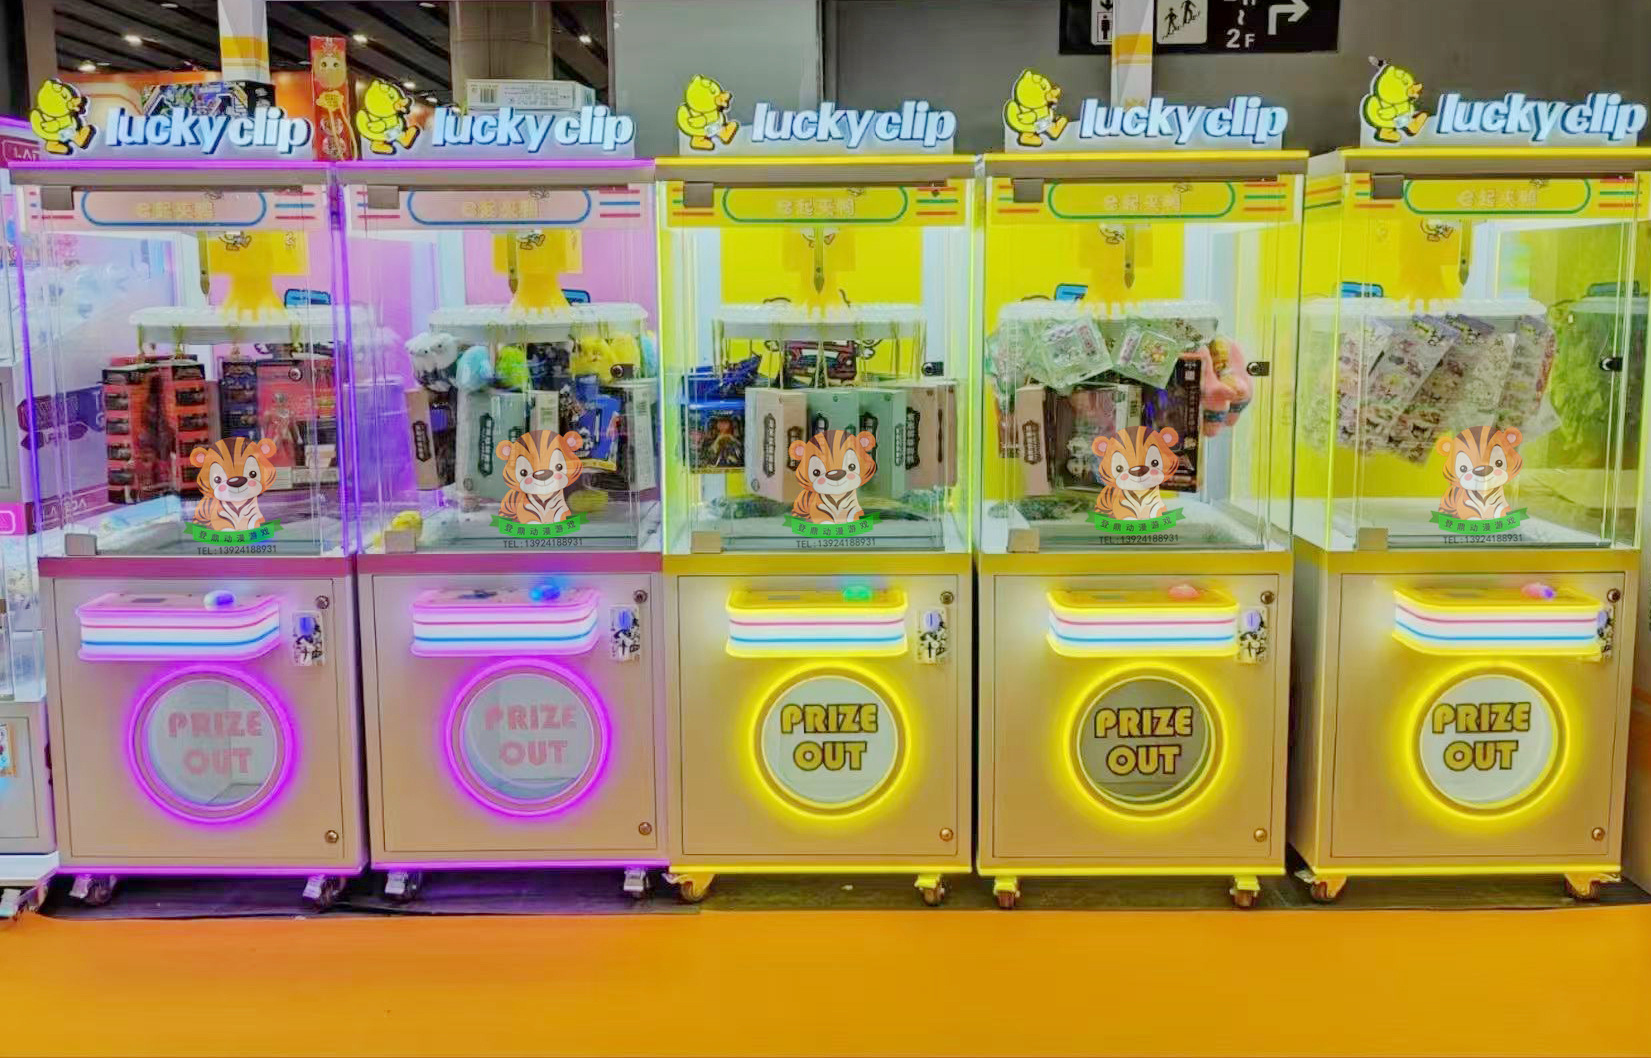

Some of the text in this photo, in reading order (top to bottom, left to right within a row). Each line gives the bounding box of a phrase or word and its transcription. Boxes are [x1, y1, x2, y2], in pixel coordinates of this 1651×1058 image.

[169, 710, 263, 737] PRIZE
[485, 704, 577, 731] PRIZE
[781, 703, 878, 734] PRIZE
[1094, 706, 1193, 738] PRIZE
[1432, 702, 1531, 734] PRIZE
[183, 747, 252, 777] OUT
[499, 740, 568, 766] OUT
[793, 741, 867, 771] OUT
[1106, 744, 1182, 776] OUT
[1443, 740, 1519, 771] OUT
